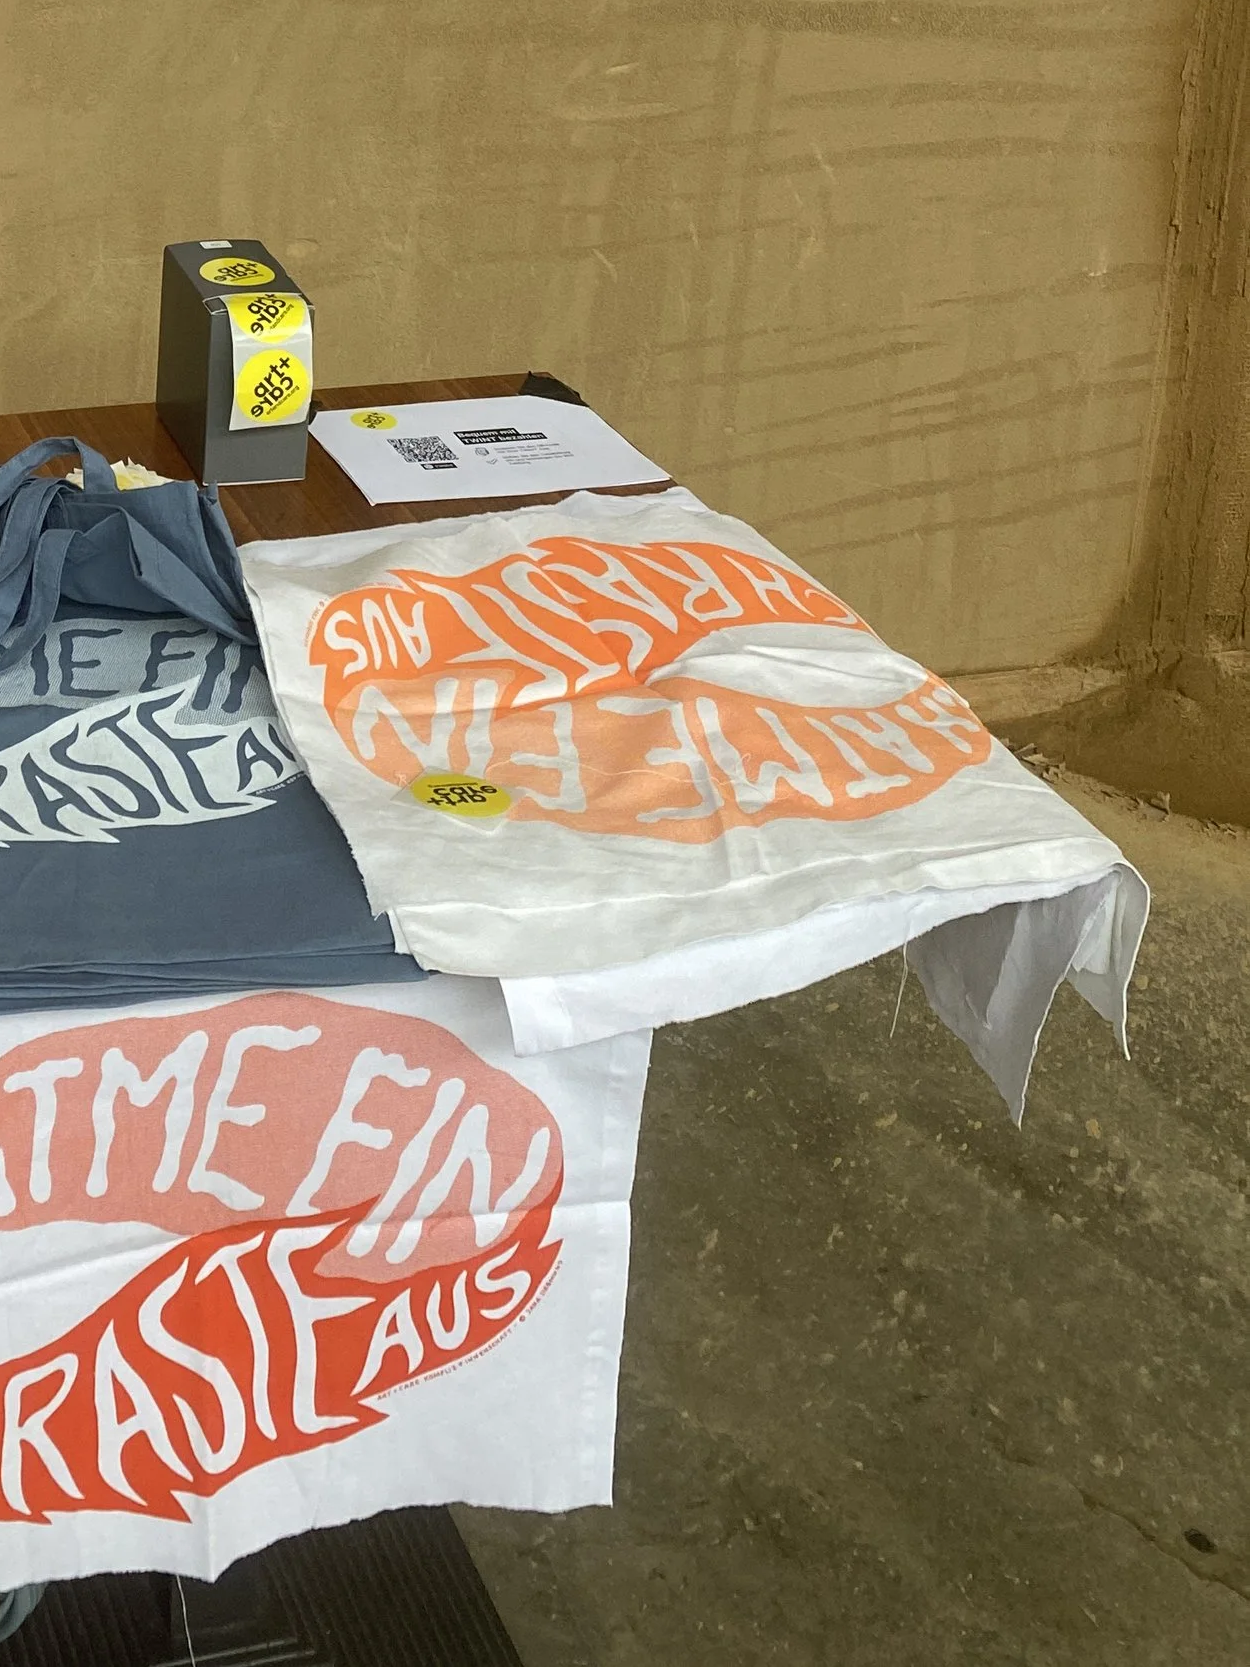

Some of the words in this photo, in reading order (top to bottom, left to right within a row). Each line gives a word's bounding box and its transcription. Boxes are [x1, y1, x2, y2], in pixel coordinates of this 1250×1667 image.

[254, 357, 290, 398] art+
[462, 436, 497, 444] TWINT
[324, 593, 432, 679] AUS
[427, 794, 488, 806] art+
[350, 1241, 531, 1396] AUS
